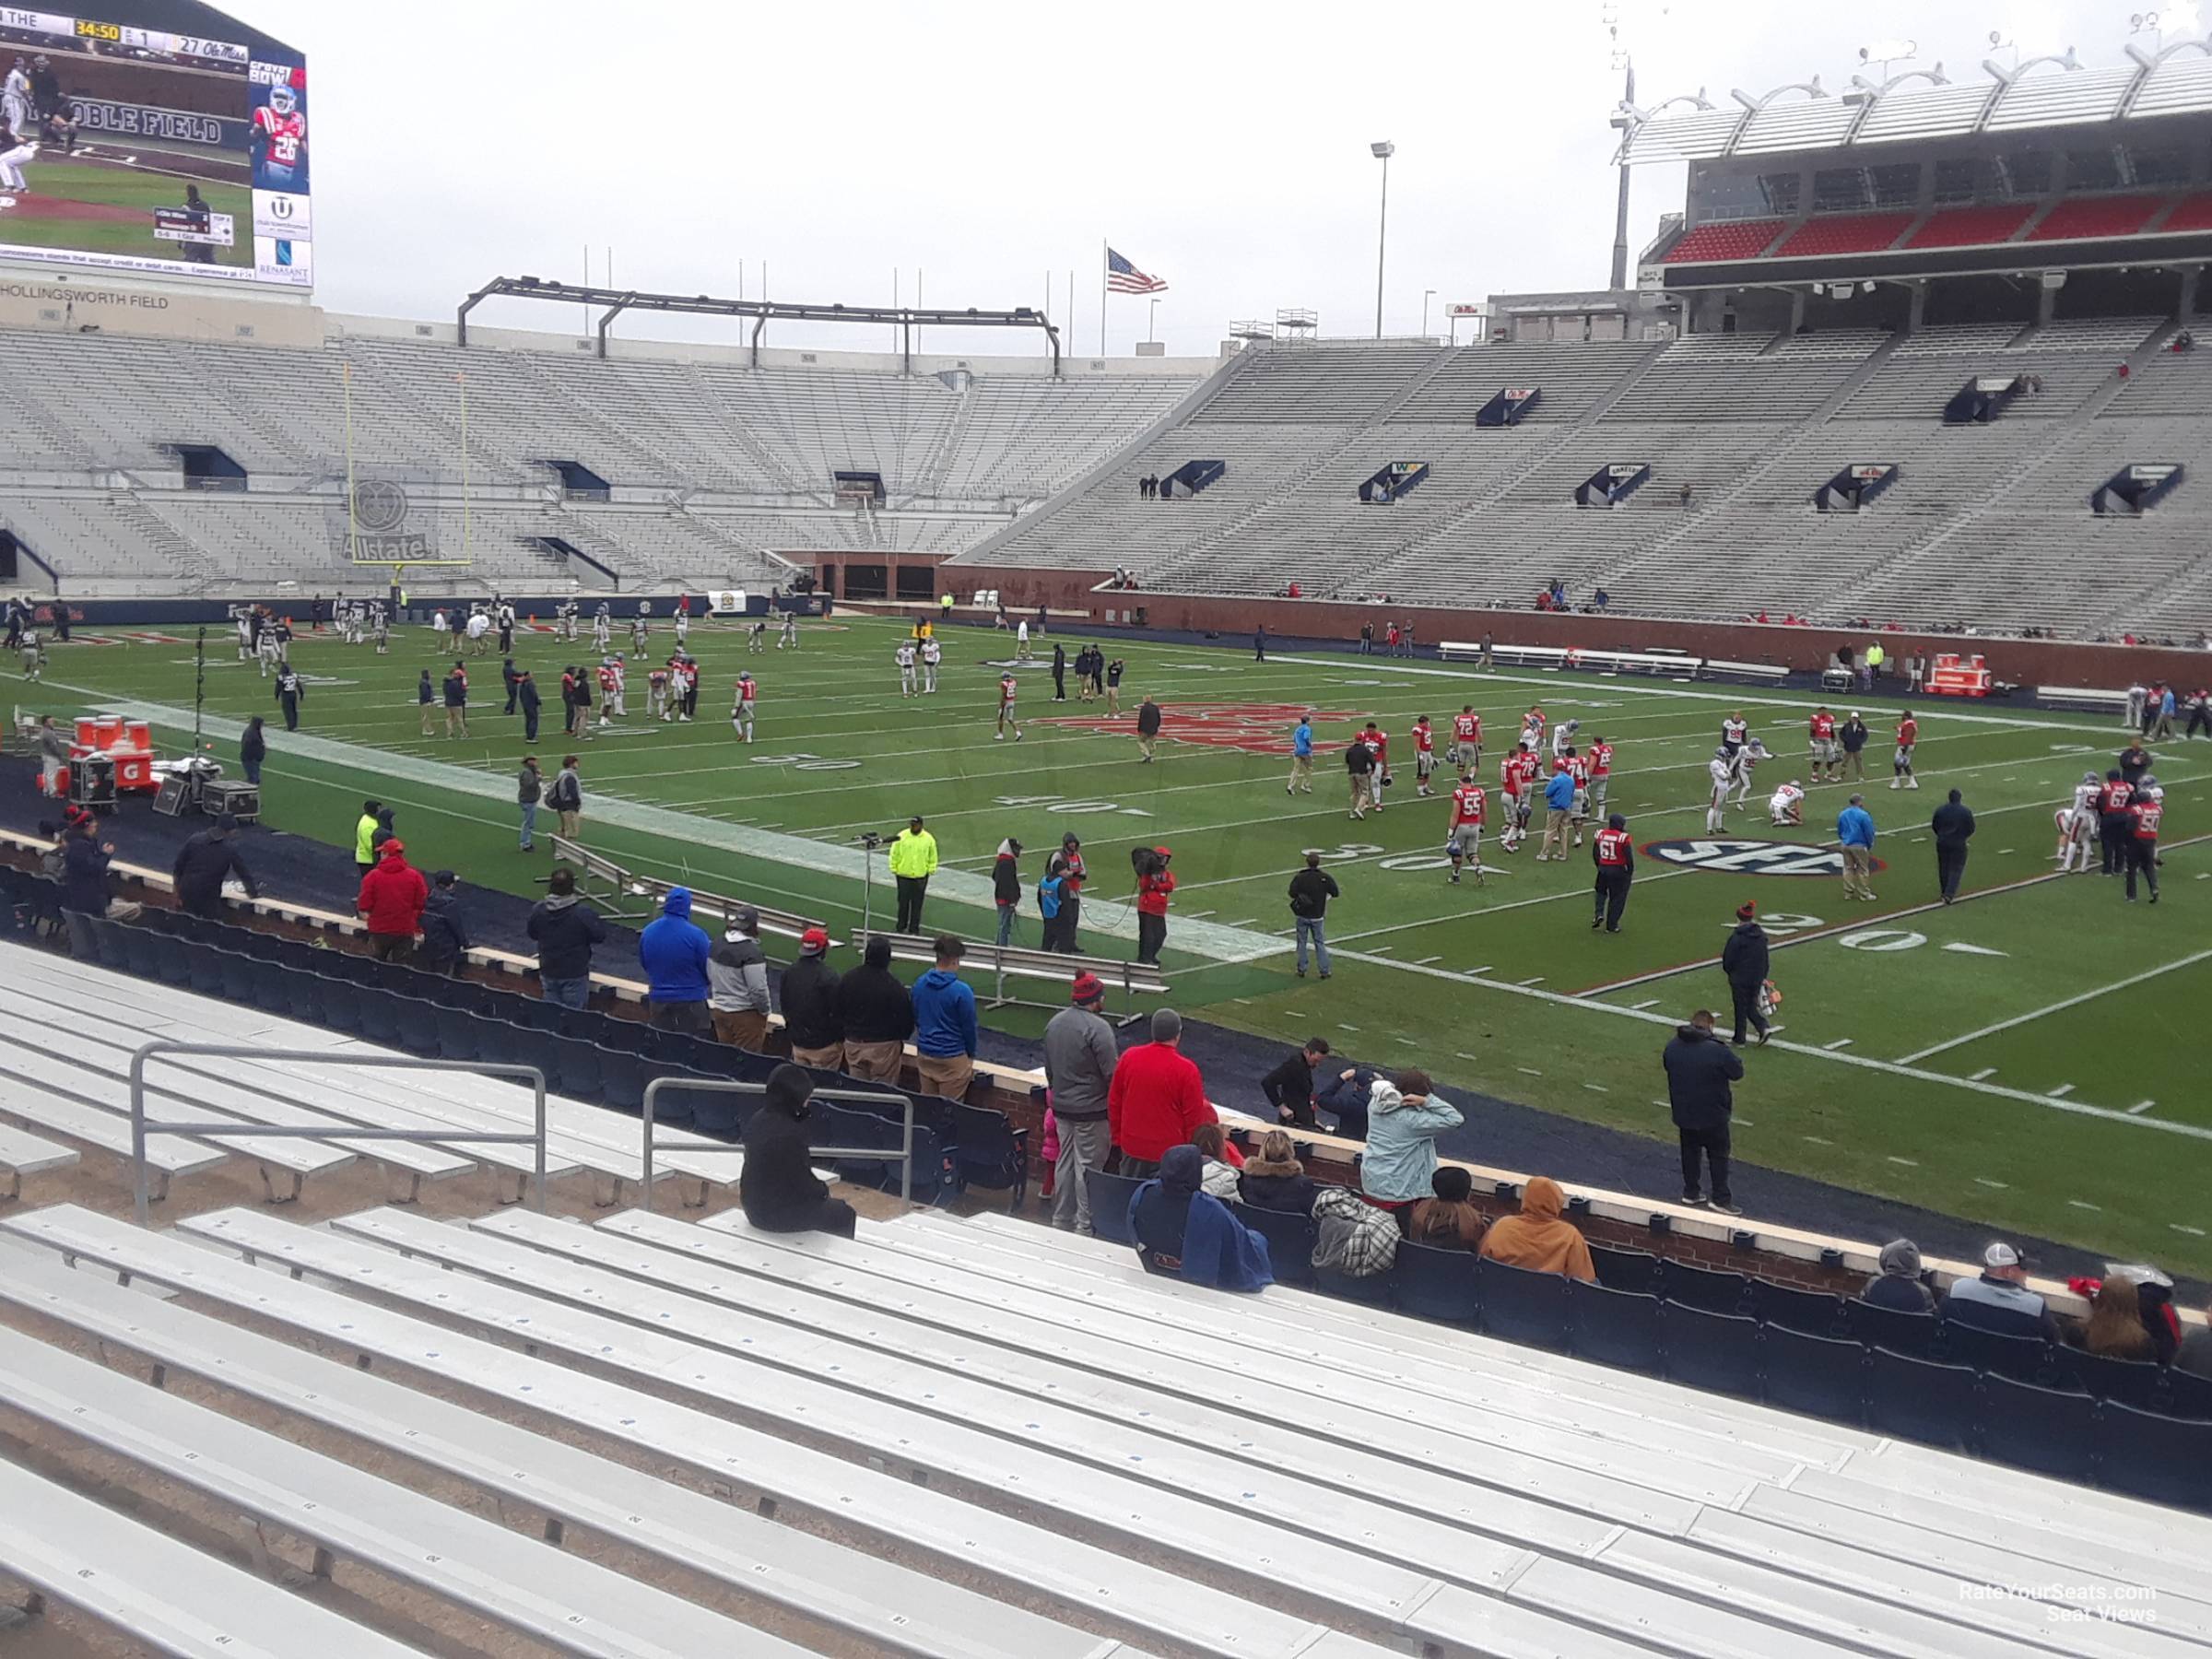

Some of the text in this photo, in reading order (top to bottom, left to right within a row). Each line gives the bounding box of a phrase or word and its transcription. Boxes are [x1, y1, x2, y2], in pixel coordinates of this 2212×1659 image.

[7, 11, 37, 27] THE
[76, 21, 120, 41] 34:50
[140, 32, 147, 45] 1
[180, 38, 198, 53] 27
[70, 101, 221, 144] OBLE FIELD
[275, 136, 299, 160] 26
[260, 265, 308, 277] RENASANT
[1, 284, 168, 310] HOLLINGSWORTH FIELD
[342, 533, 429, 561] Allstate
[1458, 722, 1473, 735] 72
[124, 765, 139, 780] G
[1464, 797, 1481, 816] 55
[1599, 840, 1617, 860] 61
